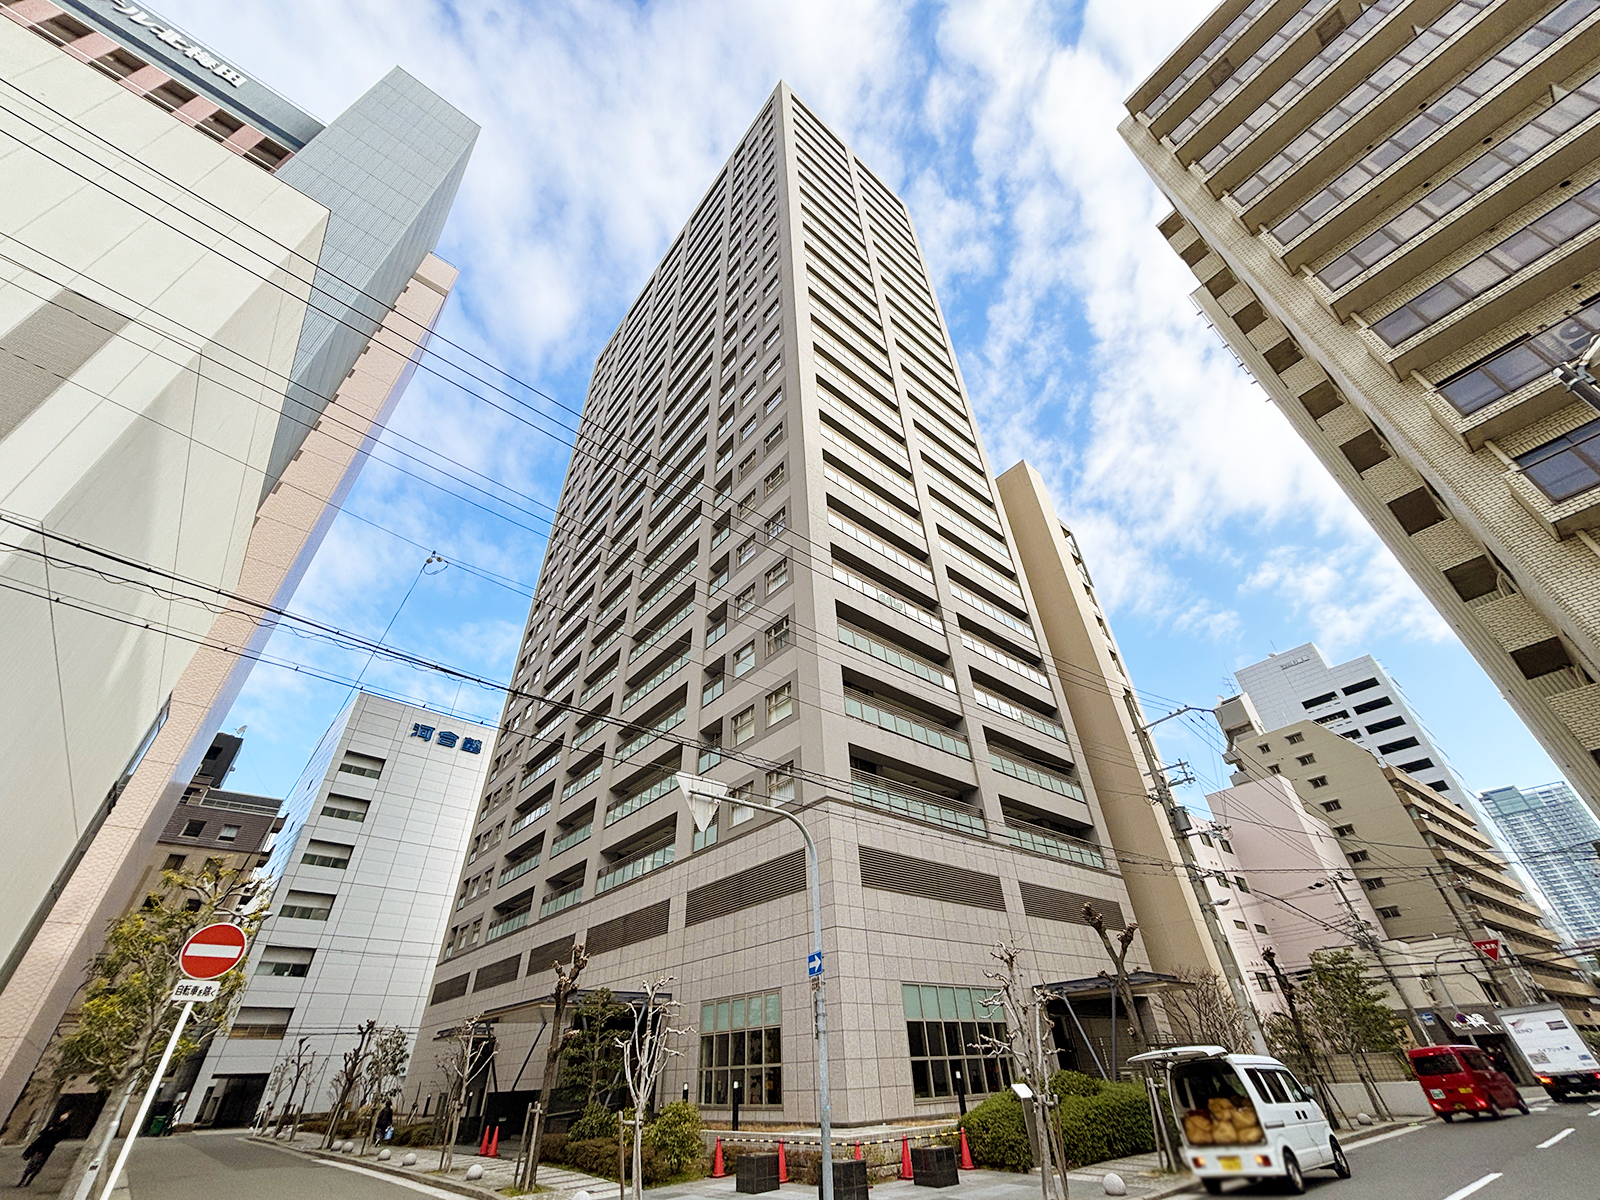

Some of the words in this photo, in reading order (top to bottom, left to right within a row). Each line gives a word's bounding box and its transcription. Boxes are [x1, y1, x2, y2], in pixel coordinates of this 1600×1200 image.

[174, 984, 217, 997] 自転車を除く
